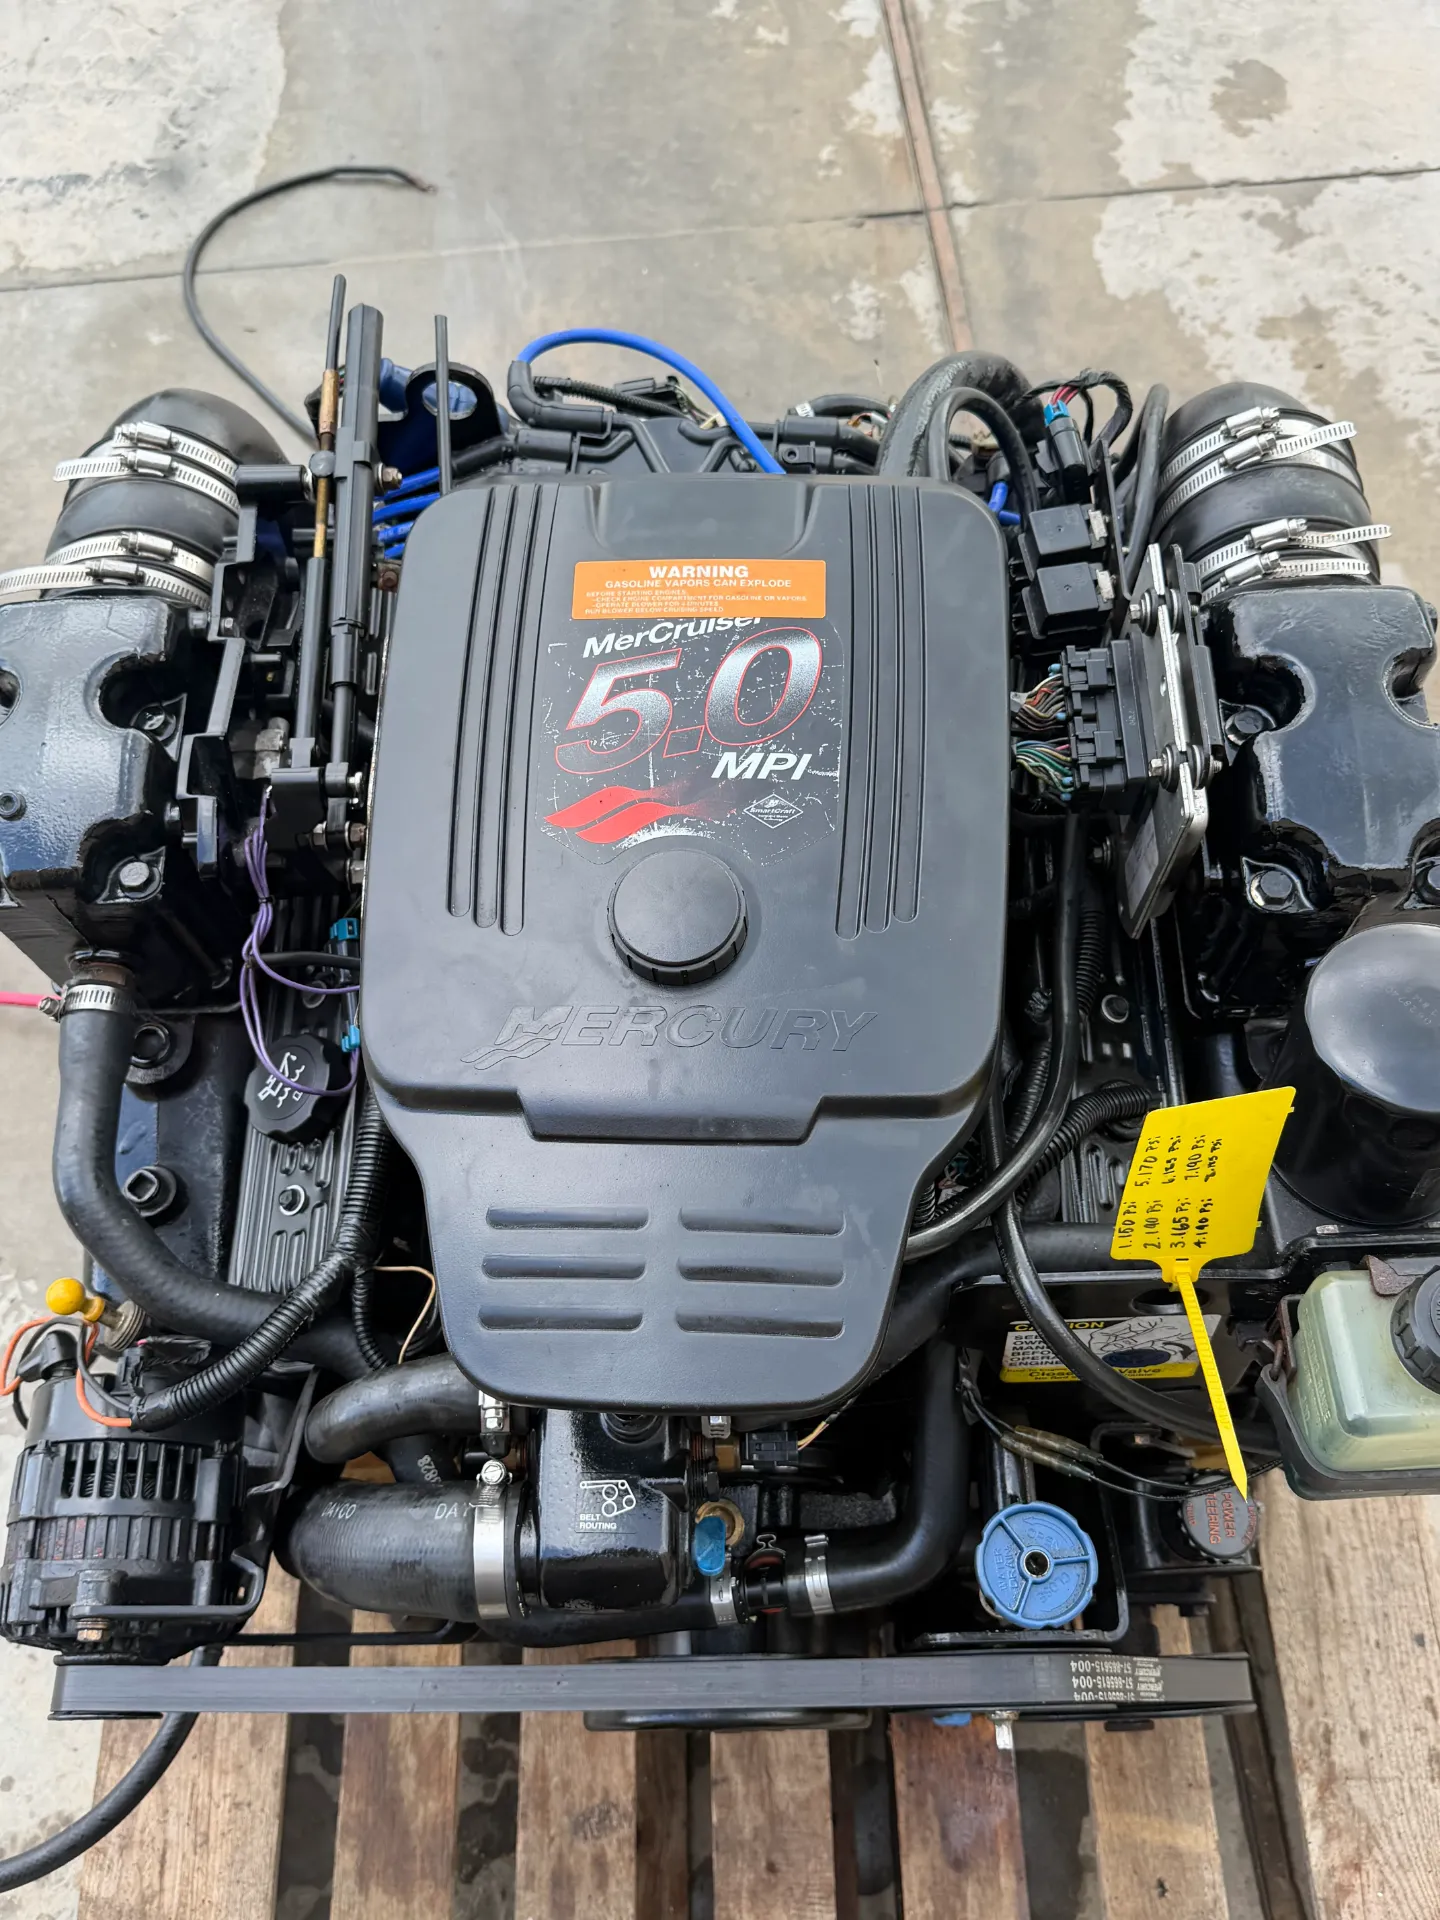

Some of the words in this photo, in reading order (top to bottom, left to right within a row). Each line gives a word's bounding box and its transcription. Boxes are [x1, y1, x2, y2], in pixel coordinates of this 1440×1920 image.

[605, 581, 661, 589] GASOLINE
[665, 580, 710, 588] VAPORS
[713, 579, 737, 587] CAN
[740, 579, 791, 588] EXPLODE
[649, 565, 749, 578] WARNING
[555, 626, 823, 775] 5.0
[711, 751, 812, 780] MPI
[493, 1004, 878, 1053] MERCURY
[1014, 1322, 1105, 1332] CION
[580, 1513, 601, 1521] BELT
[580, 1521, 617, 1530] ROUTING
[1205, 1492, 1221, 1545] TEERING
[1221, 1492, 1236, 1537] POWER
[993, 1548, 1008, 1591] WATER
